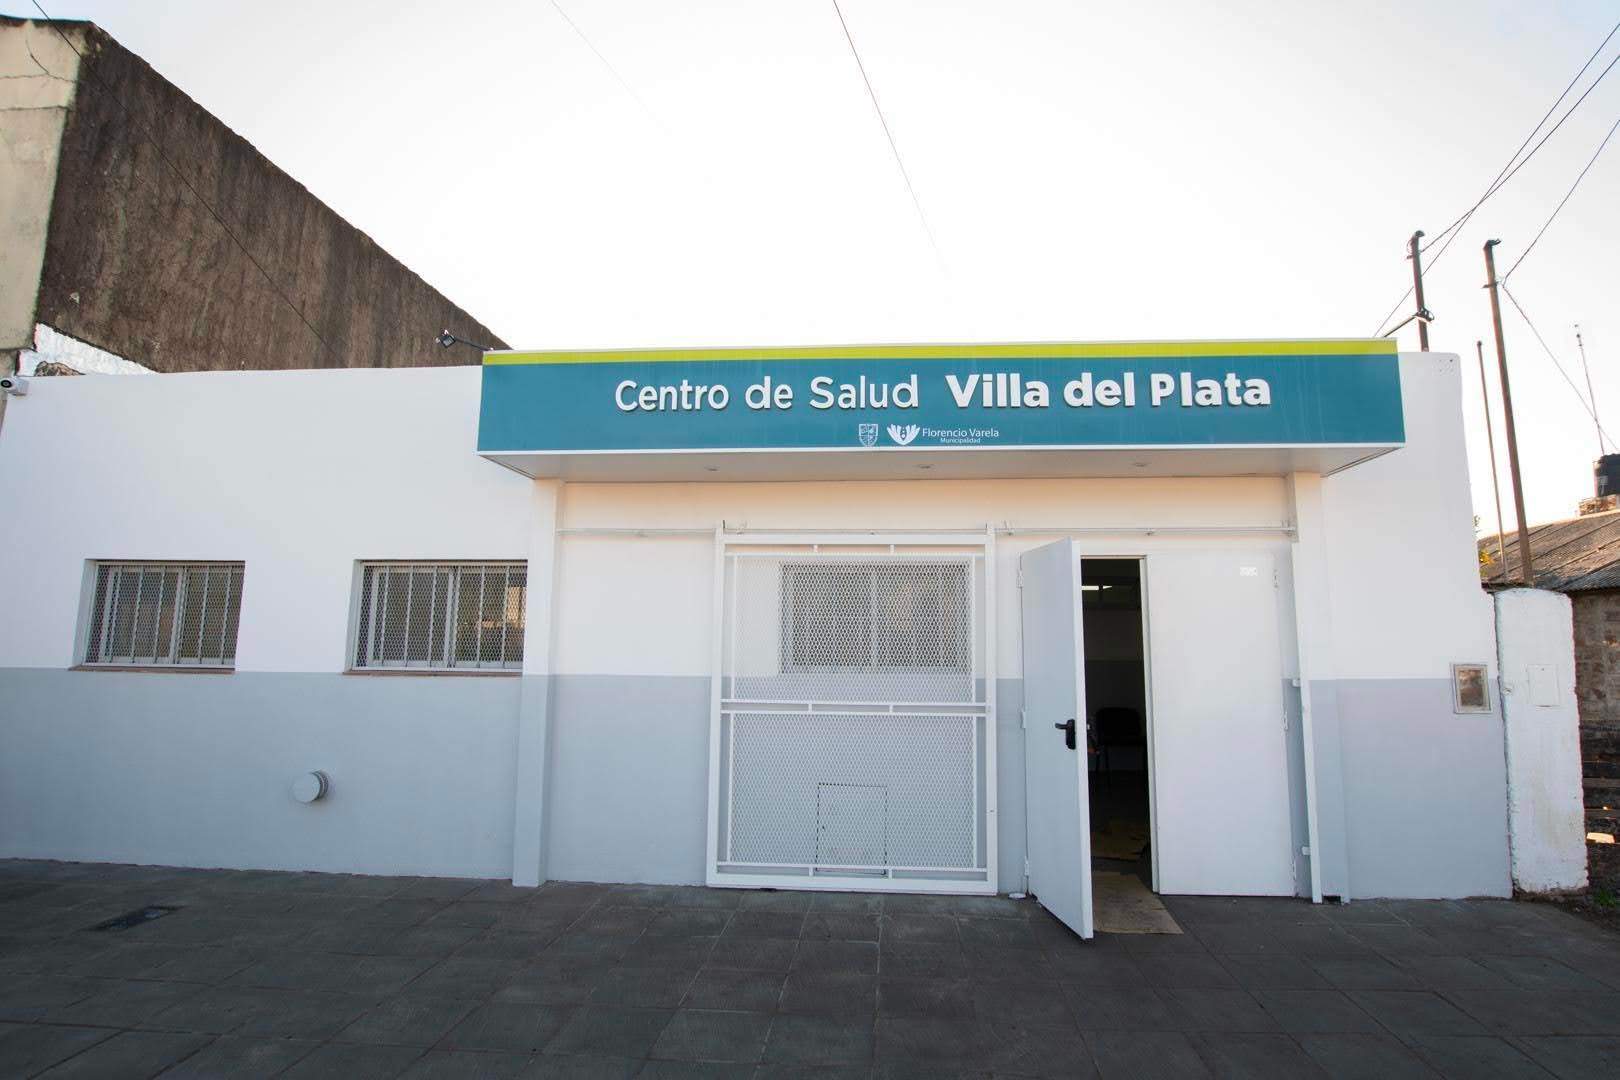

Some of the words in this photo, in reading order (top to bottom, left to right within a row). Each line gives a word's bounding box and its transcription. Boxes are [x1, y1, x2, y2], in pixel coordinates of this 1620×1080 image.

[615, 380, 729, 411] Centro
[745, 376, 793, 410] de
[809, 375, 919, 409] Salud
[945, 373, 1050, 408] Villa
[1063, 372, 1136, 407] del
[1150, 372, 1271, 406] Plata
[922, 428, 967, 438] Florencio
[969, 428, 999, 437] Varela
